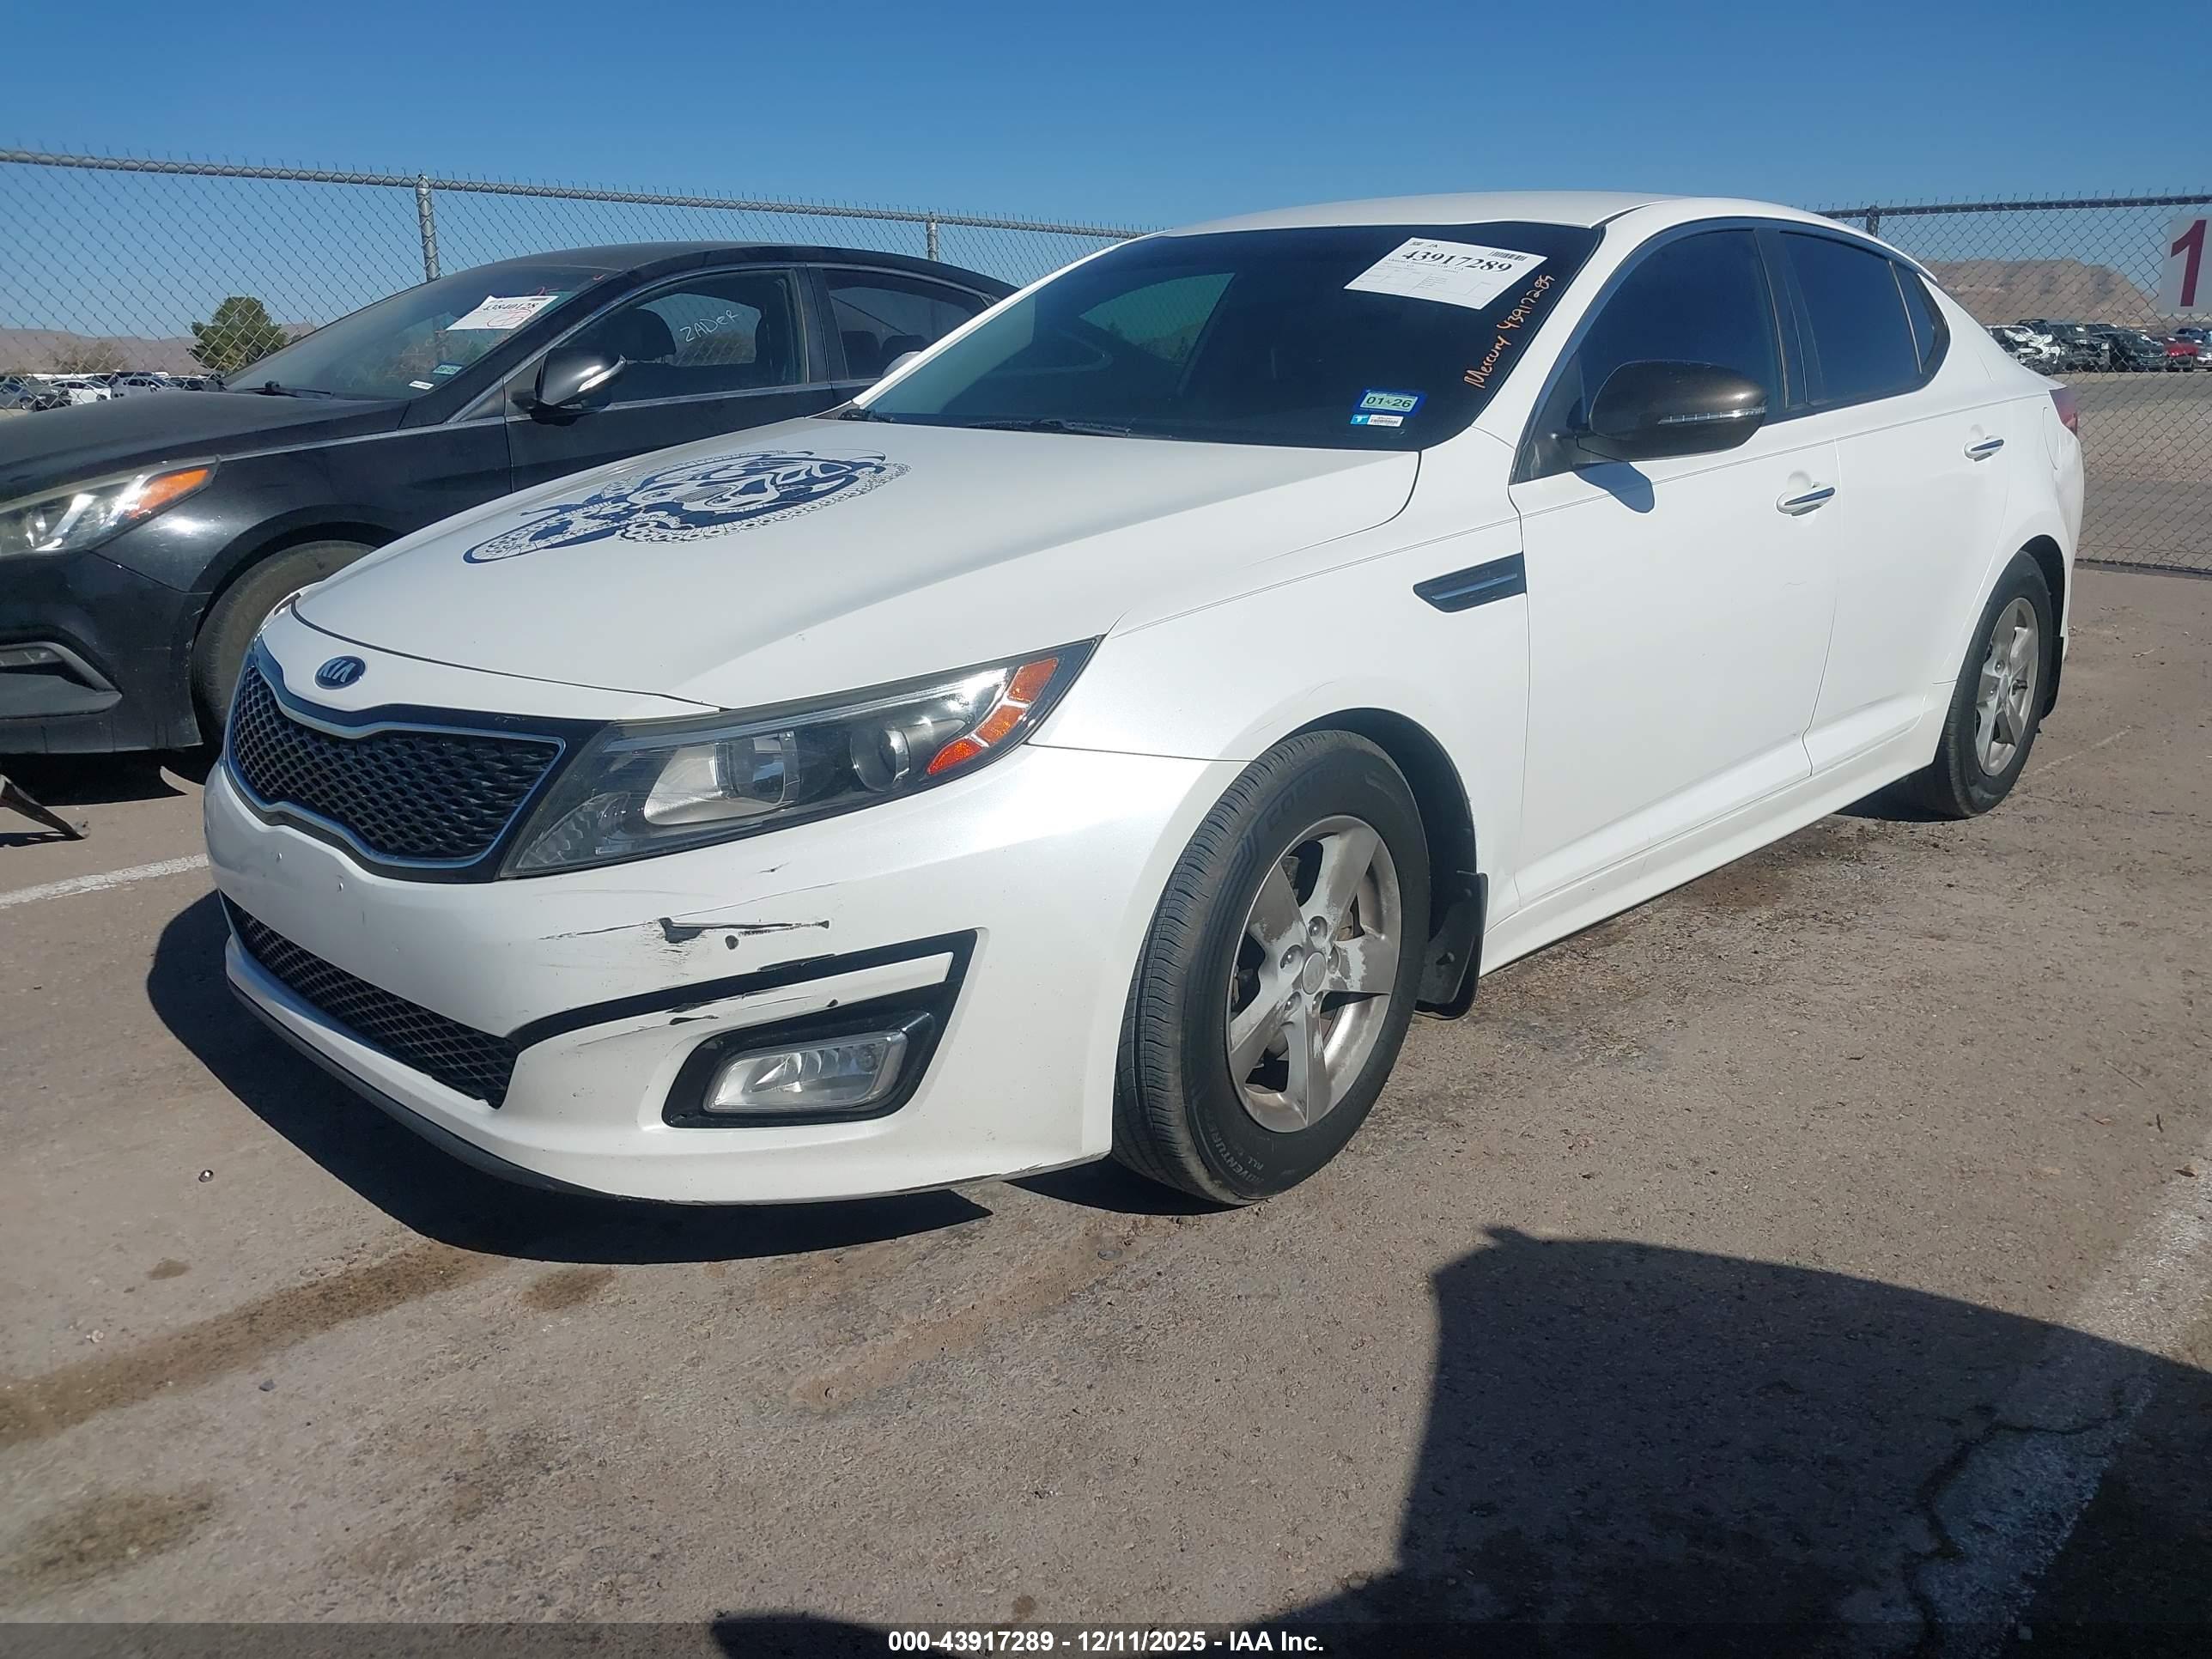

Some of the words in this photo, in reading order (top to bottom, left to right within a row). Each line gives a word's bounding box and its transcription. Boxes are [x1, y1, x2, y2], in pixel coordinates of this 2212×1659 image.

[1401, 250, 1513, 273] 43917289
[2171, 220, 2207, 307] 1
[1463, 335, 1512, 389] Mercury
[1496, 274, 1556, 329] 43917289
[318, 659, 356, 683] KIA
